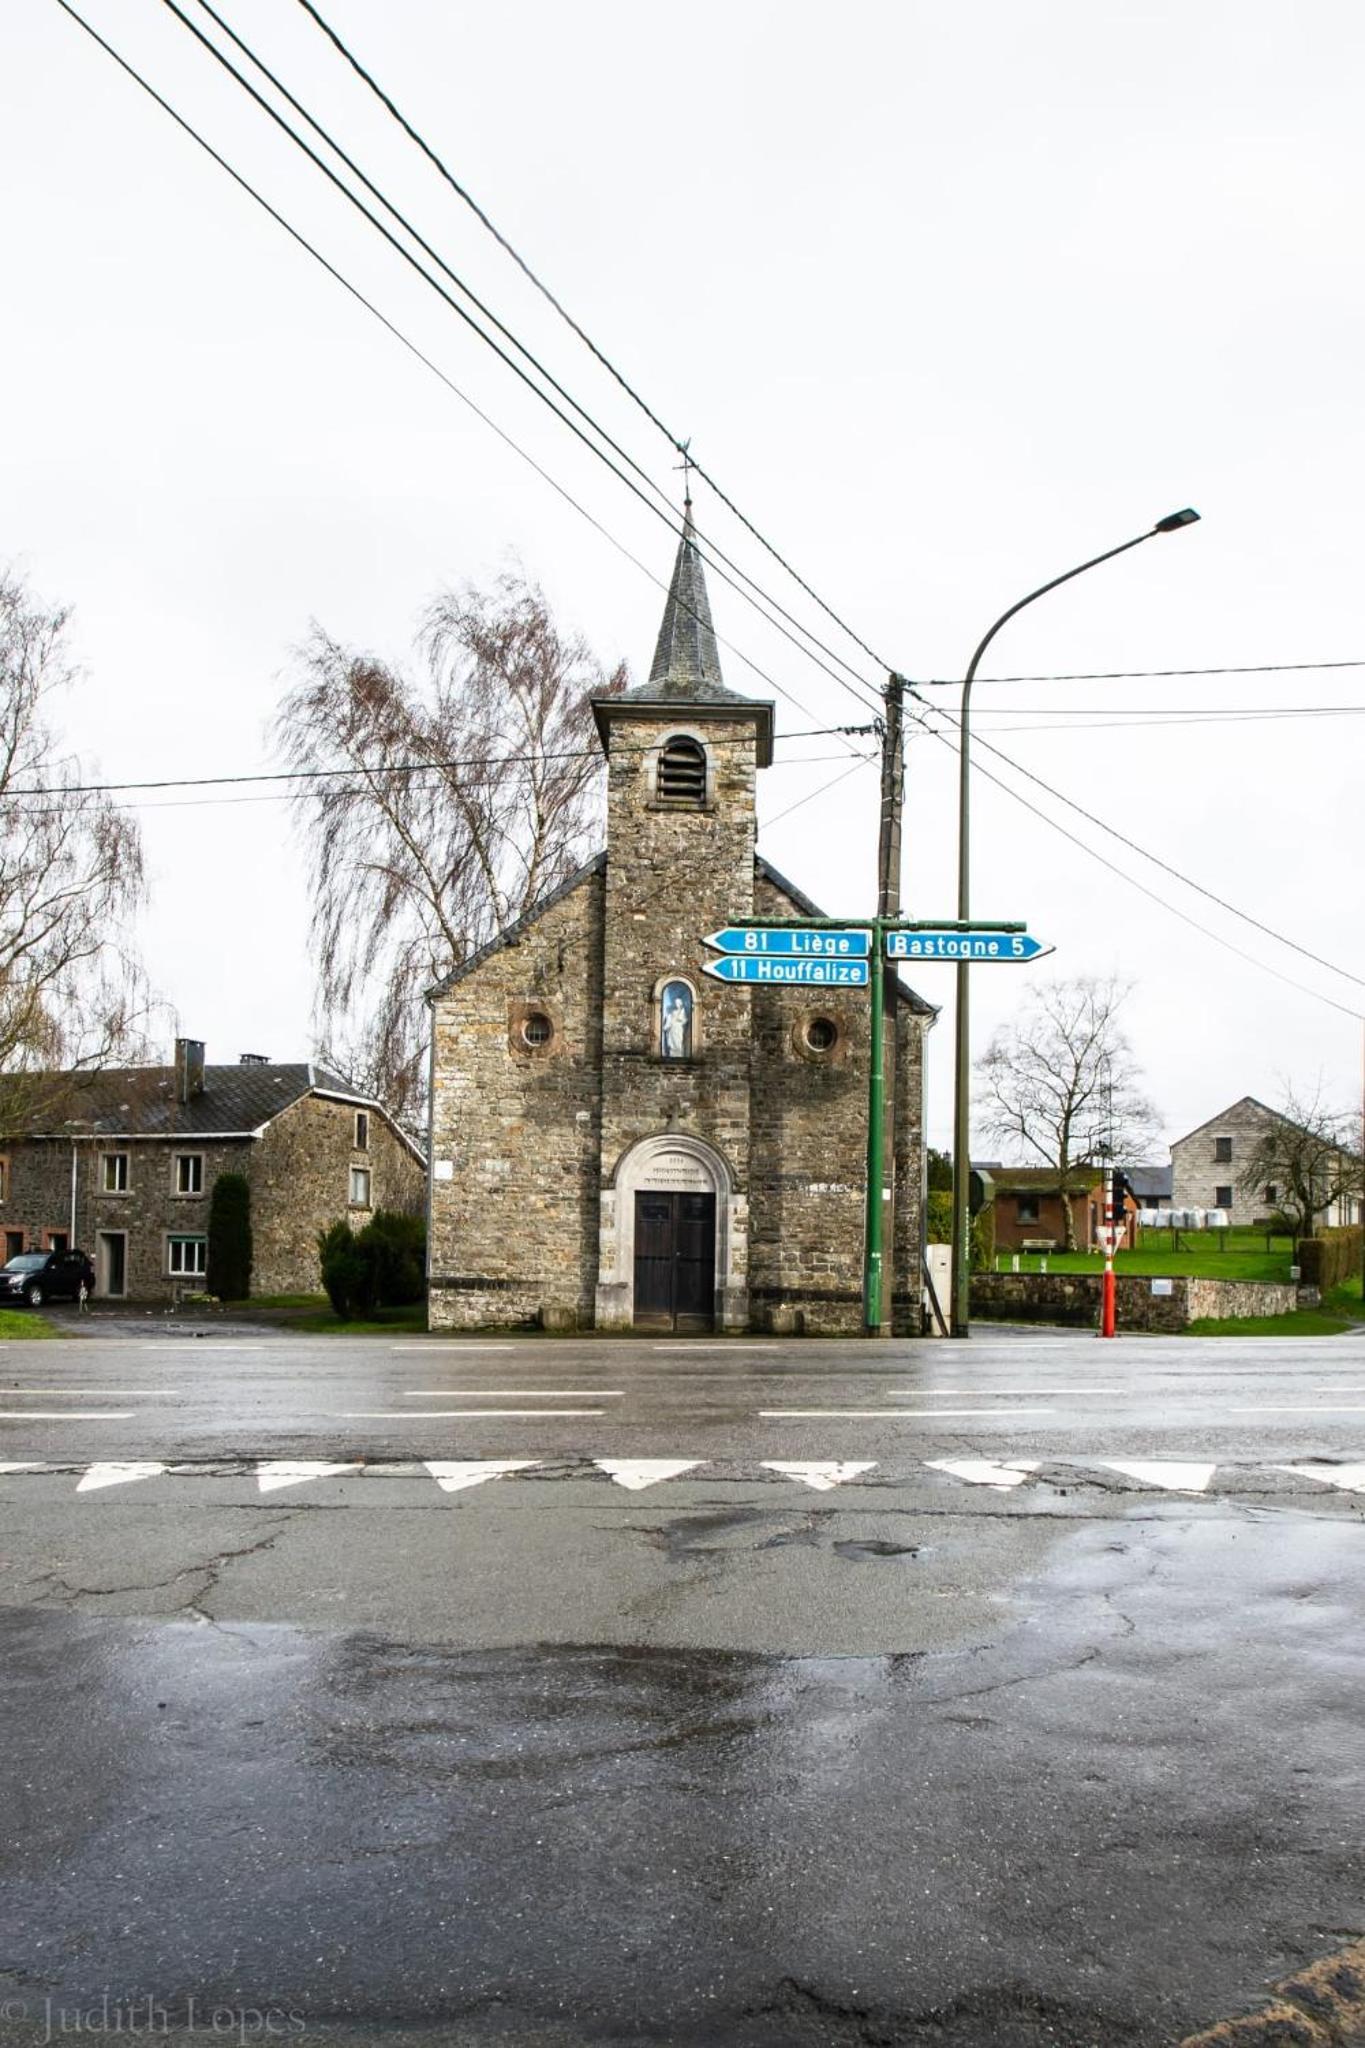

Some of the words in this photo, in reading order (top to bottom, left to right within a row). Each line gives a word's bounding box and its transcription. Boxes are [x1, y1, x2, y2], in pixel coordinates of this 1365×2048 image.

[744, 932, 768, 950] 81
[791, 933, 850, 955] Liège
[894, 936, 999, 957] Bastogne
[1011, 937, 1025, 956] 5
[731, 959, 747, 976] 11
[757, 960, 862, 982] Houffalize
